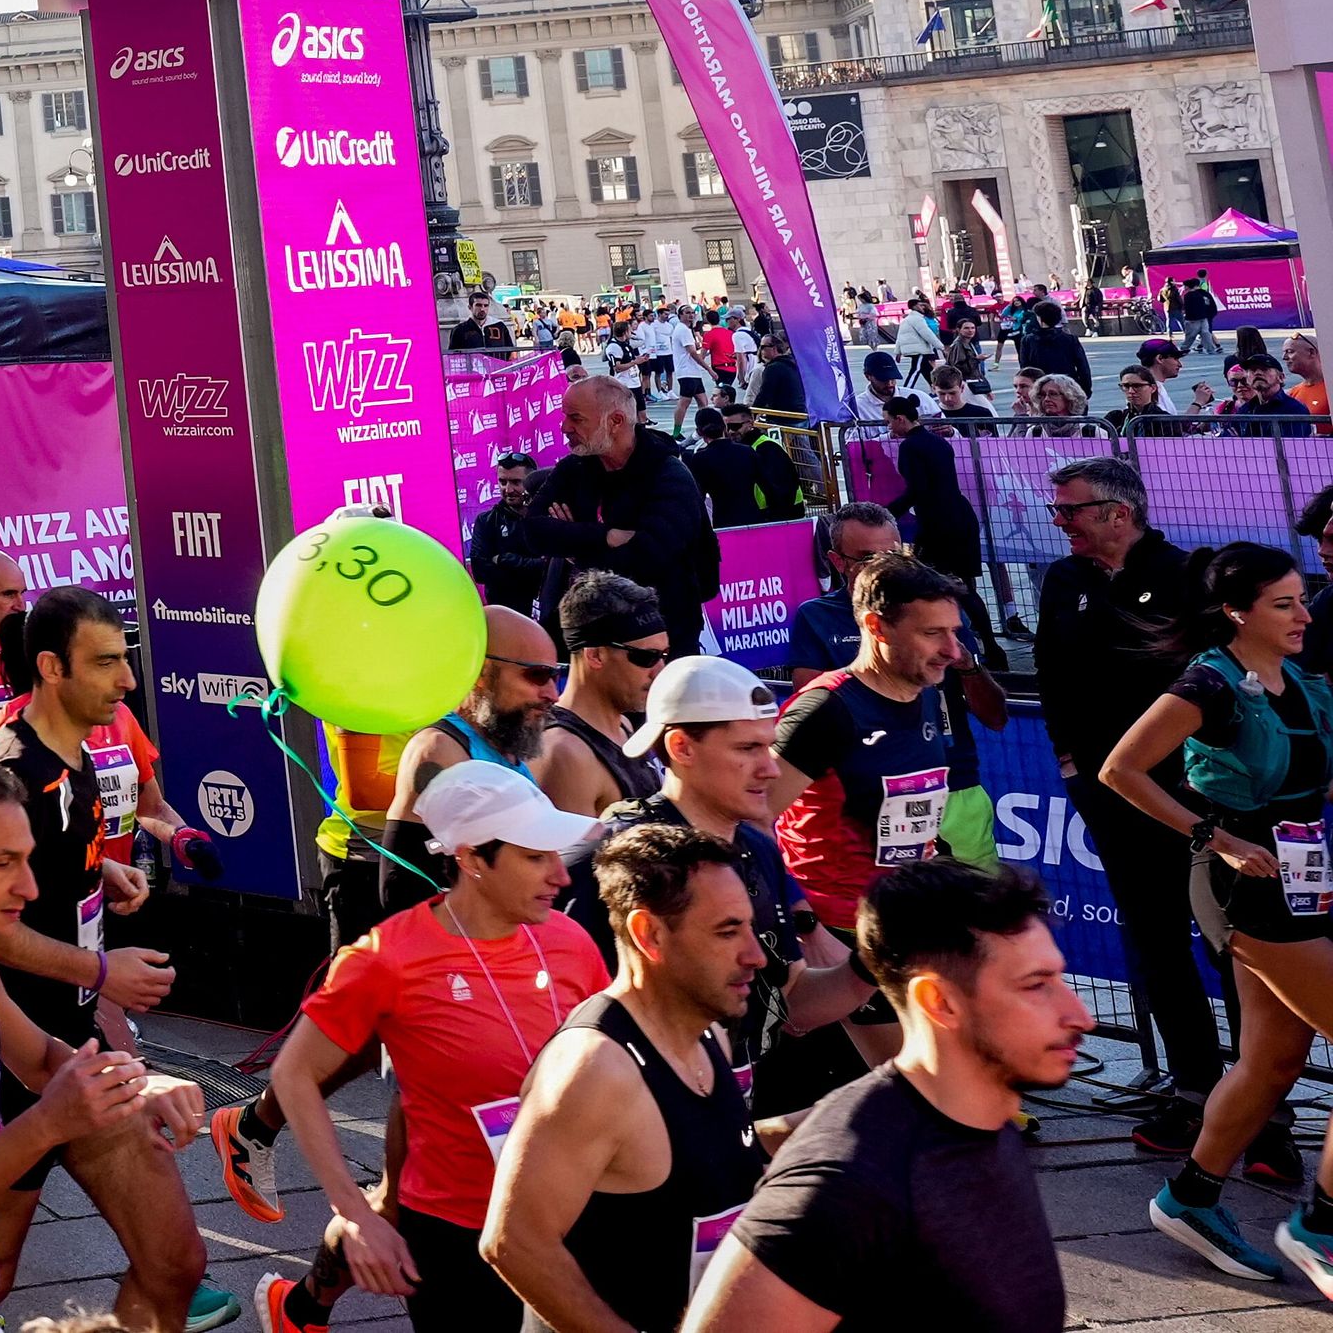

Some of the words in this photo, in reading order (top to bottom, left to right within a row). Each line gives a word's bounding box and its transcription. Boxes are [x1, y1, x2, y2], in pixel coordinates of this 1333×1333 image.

[300, 72, 322, 85] sound
[341, 72, 363, 85] sound
[363, 72, 382, 88] body
[135, 147, 212, 175] UniCredit
[302, 129, 397, 167] UniCredit
[122, 255, 219, 288] LEVISSIMA
[284, 242, 407, 293] LEVISSIMA
[1226, 294, 1272, 304] MILANO
[1227, 302, 1273, 310] MARATHON
[162, 422, 235, 438] wizzair.com
[336, 418, 422, 445] wizzair.com
[85, 506, 130, 540] AIR
[172, 511, 222, 559] FIAT
[719, 579, 751, 602] WIZZ
[754, 576, 784, 599] AIR
[721, 601, 788, 631] MILANO
[723, 627, 791, 653] MARATHON
[160, 675, 196, 701] sky
[201, 677, 239, 700] wifi
[206, 788, 245, 809] RTL
[209, 804, 246, 821] 102.5
